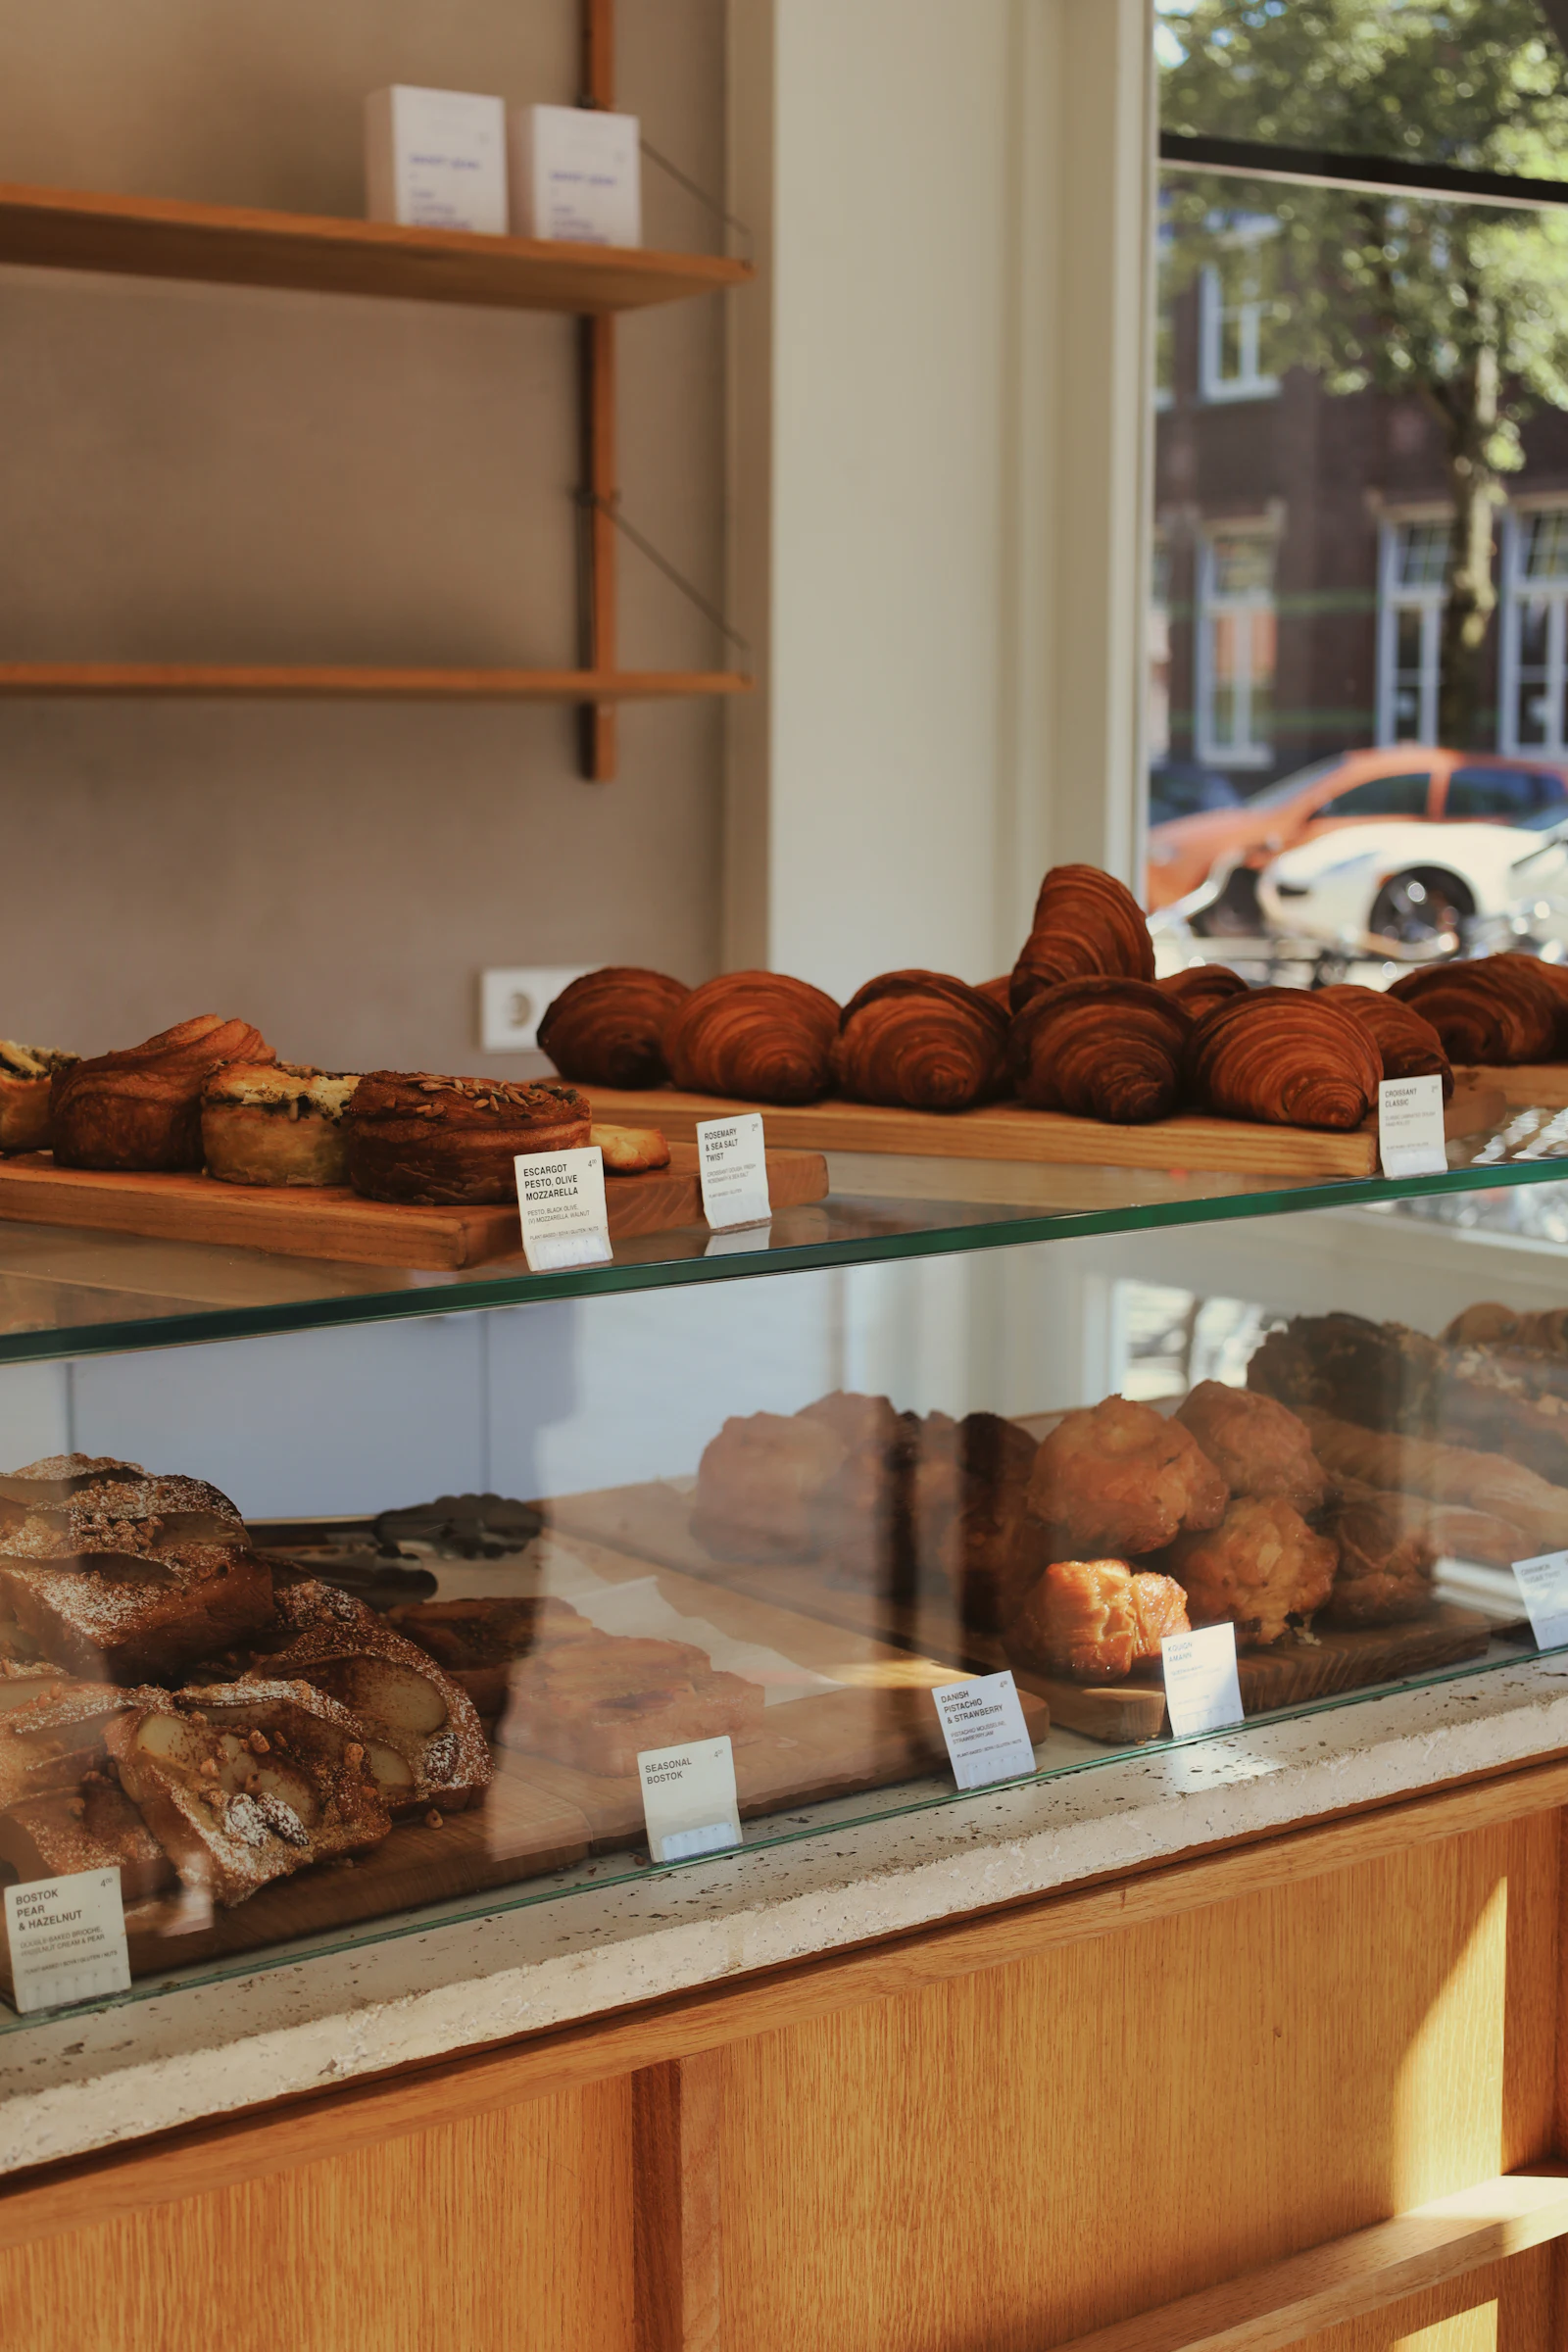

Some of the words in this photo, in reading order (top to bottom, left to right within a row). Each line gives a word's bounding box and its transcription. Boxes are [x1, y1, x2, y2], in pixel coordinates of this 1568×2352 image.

[1385, 1088, 1417, 1098] CROISSANT
[1385, 1099, 1408, 1107] CLASSIC
[704, 1128, 737, 1140] ROSEMARY
[711, 1142, 723, 1150] SEA
[724, 1139, 738, 1148] SALT
[706, 1152, 724, 1162] TWIST
[524, 1164, 567, 1176] ESCARGOT
[525, 1178, 554, 1189] PESTO,
[556, 1175, 578, 1185] OLIVE
[526, 1187, 578, 1201] MOZZARELLA
[528, 1208, 546, 1216] PESTO,
[570, 1210, 590, 1218] WALNUT
[1169, 1652, 1192, 1662] AMANN
[941, 1690, 969, 1703] DANISH
[944, 1698, 982, 1713] PISTACHIO
[954, 1704, 1004, 1723] STRAWBERRY
[951, 1728, 976, 1737] PISTACHIO
[953, 1733, 984, 1745] STRAWBERRY
[645, 1758, 692, 1773] SEASONAL
[647, 1771, 683, 1784] BOSTOK
[16, 1889, 58, 1905] BOSTOK
[17, 1905, 45, 1918] PEAR
[19, 1922, 25, 1931] &
[29, 1910, 82, 1929] HAZELNUT
[57, 1939, 80, 1950] CREAM
[87, 1934, 105, 1943] PEAR
[80, 1954, 100, 1963] GLUTEN
